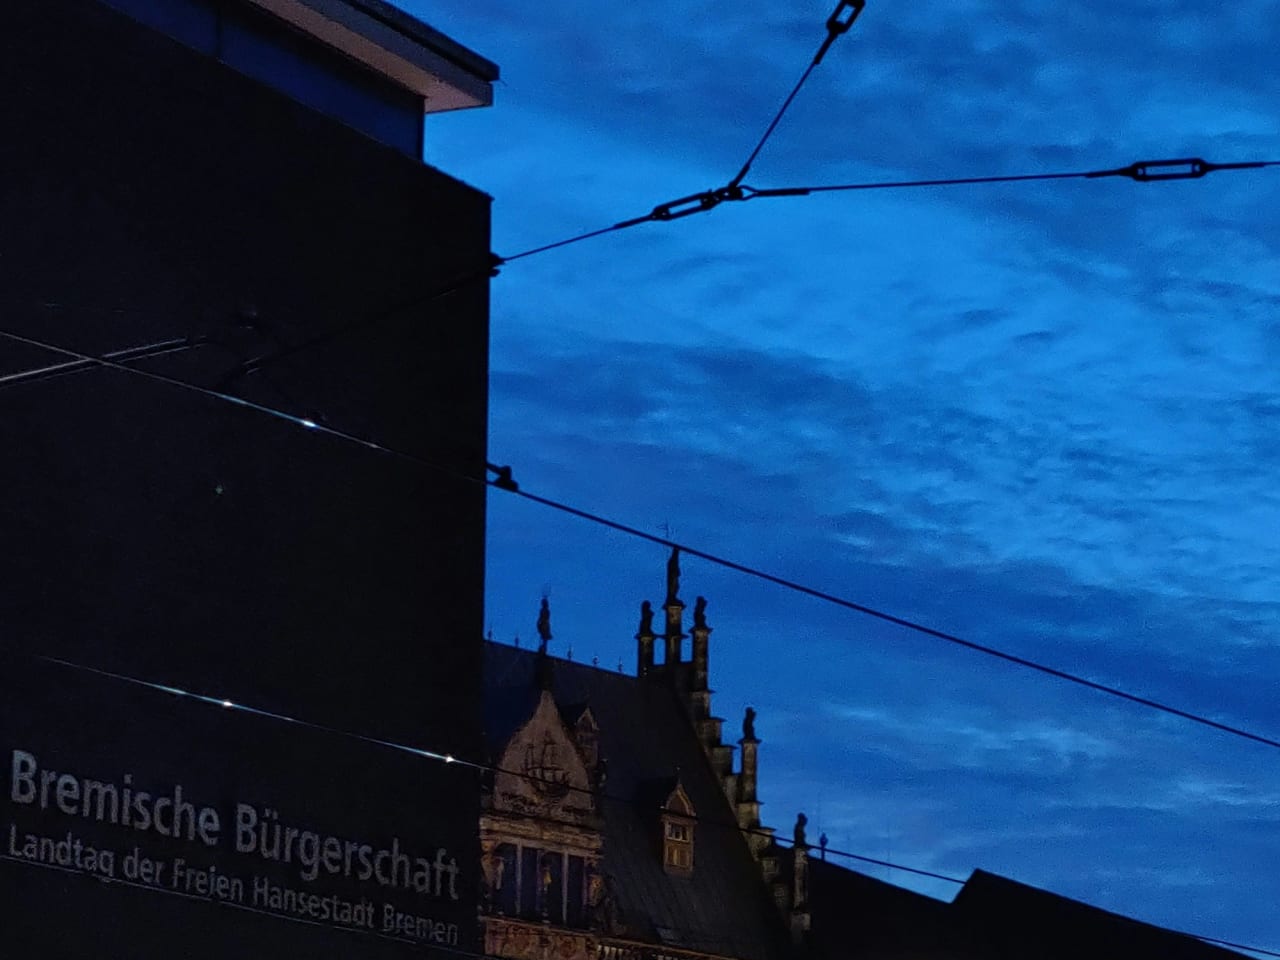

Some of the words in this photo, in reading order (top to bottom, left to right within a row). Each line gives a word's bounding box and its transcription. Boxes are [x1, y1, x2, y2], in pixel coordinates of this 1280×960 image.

[8, 822, 115, 878] Landtag
[123, 846, 166, 885] der
[172, 857, 244, 902] Freien
[253, 874, 375, 930] Hansestadt
[382, 902, 460, 946] Bremen
[11, 749, 221, 846] Bremische
[235, 802, 460, 900] Bürgerschaft
